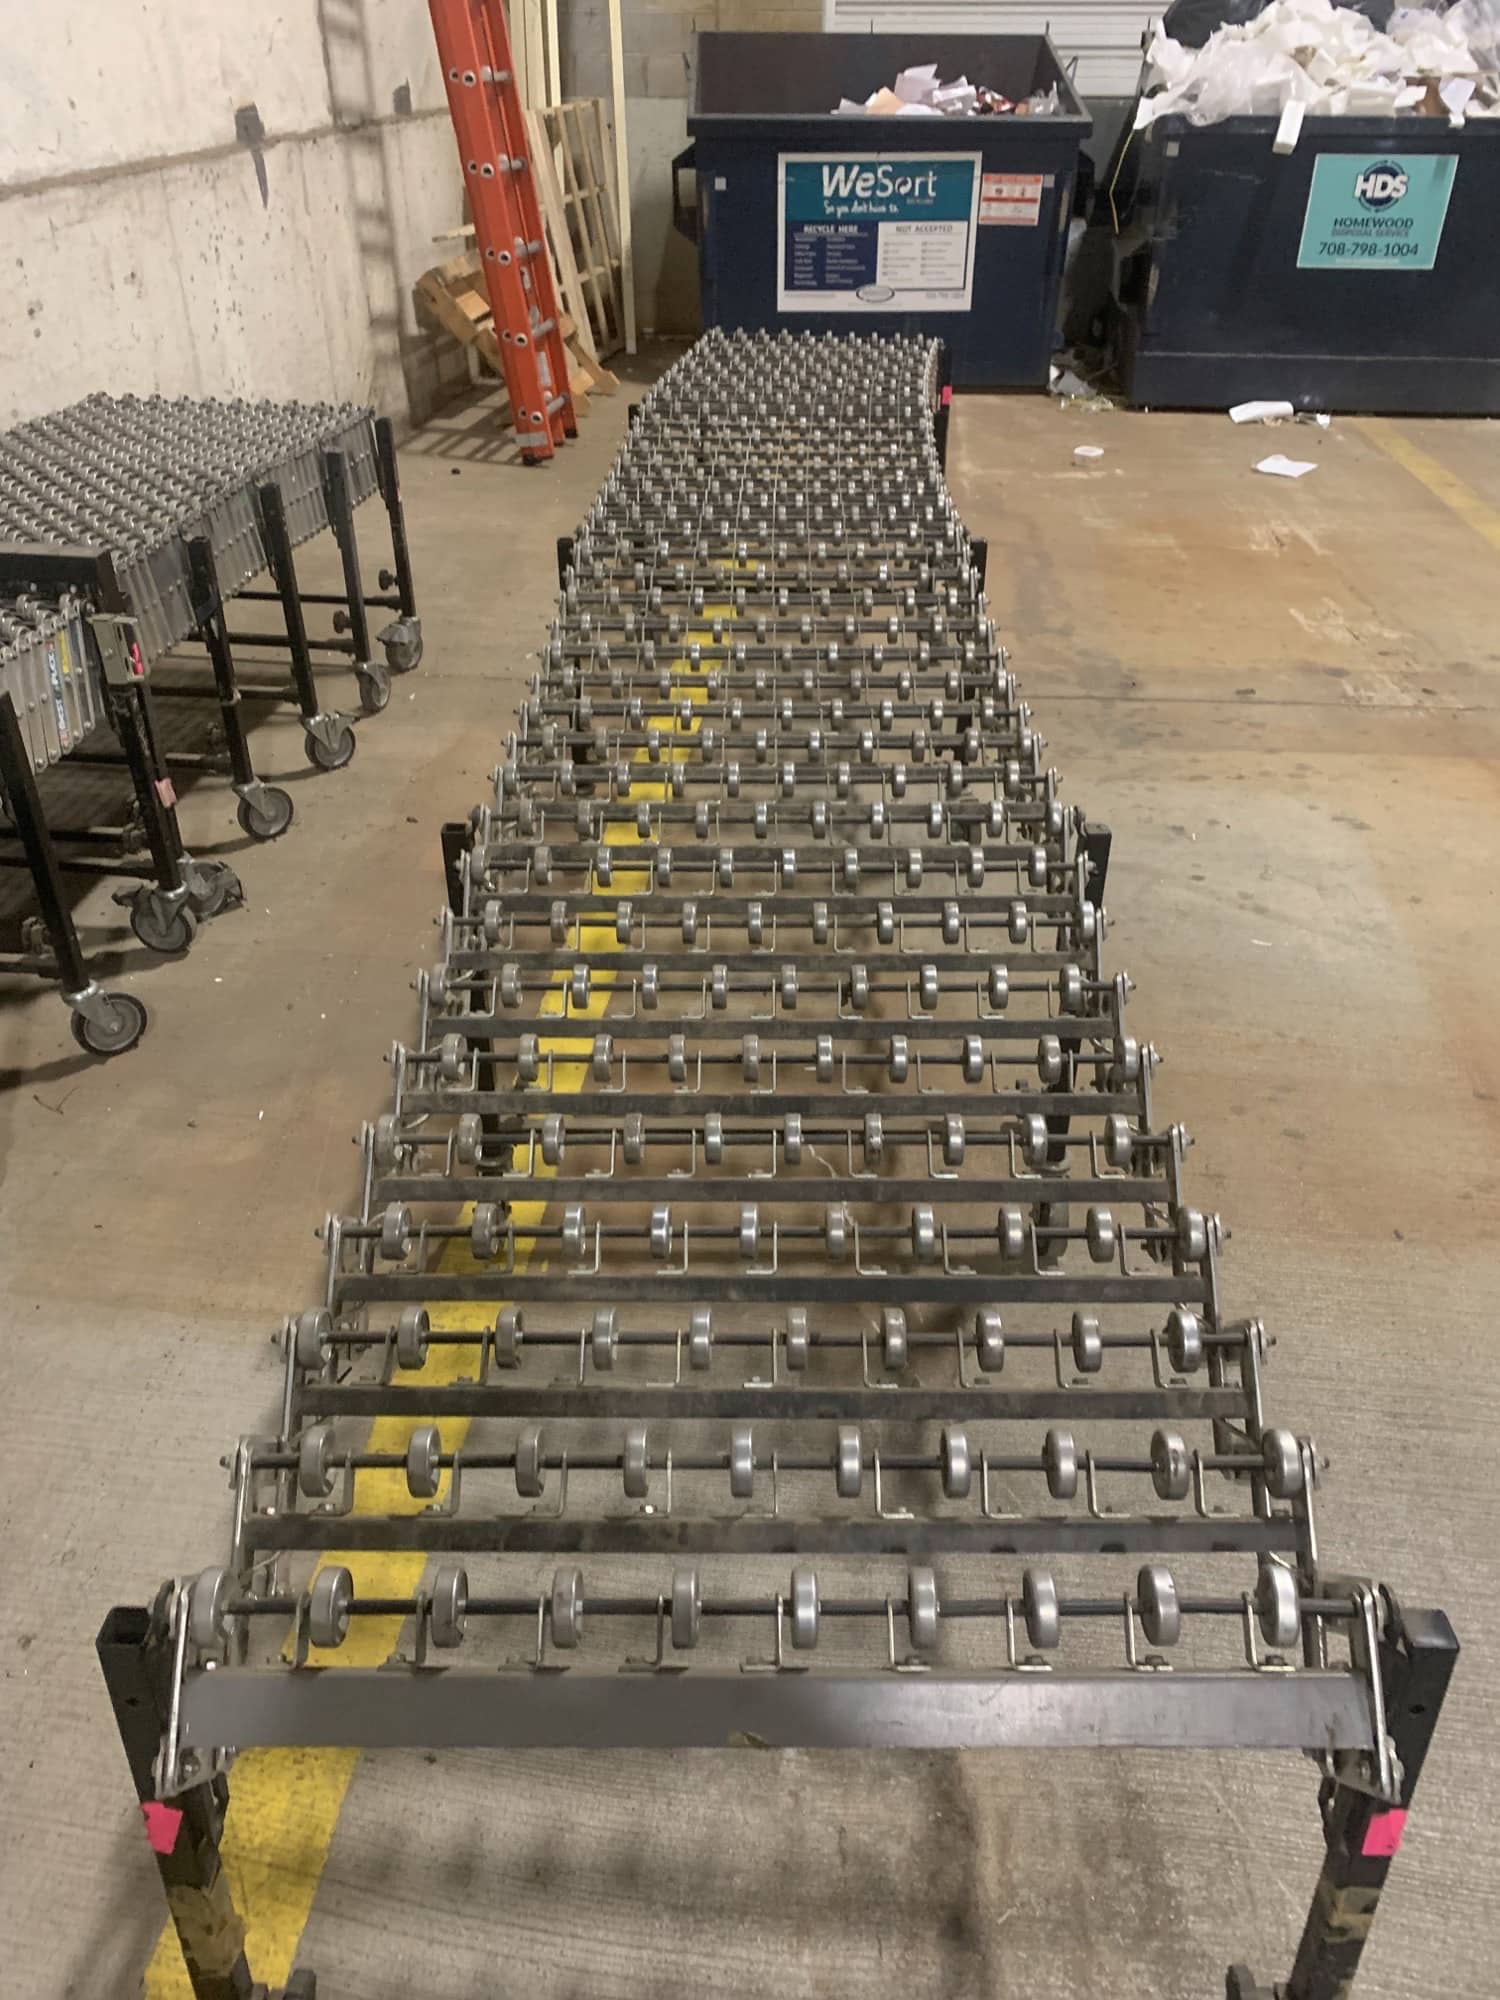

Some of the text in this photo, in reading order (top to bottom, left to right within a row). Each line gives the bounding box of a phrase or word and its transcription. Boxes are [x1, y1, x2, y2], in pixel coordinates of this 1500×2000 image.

[822, 164, 937, 197] WeSort
[1354, 173, 1409, 199] HDS
[1333, 217, 1414, 228] HOMEWOOD
[803, 225, 859, 233] RECYCLE HERE
[896, 225, 953, 233] NOT ACCEPTED
[1332, 228, 1409, 237] DISPOSAL SERVICE
[1318, 242, 1419, 256] 708-798-1004
